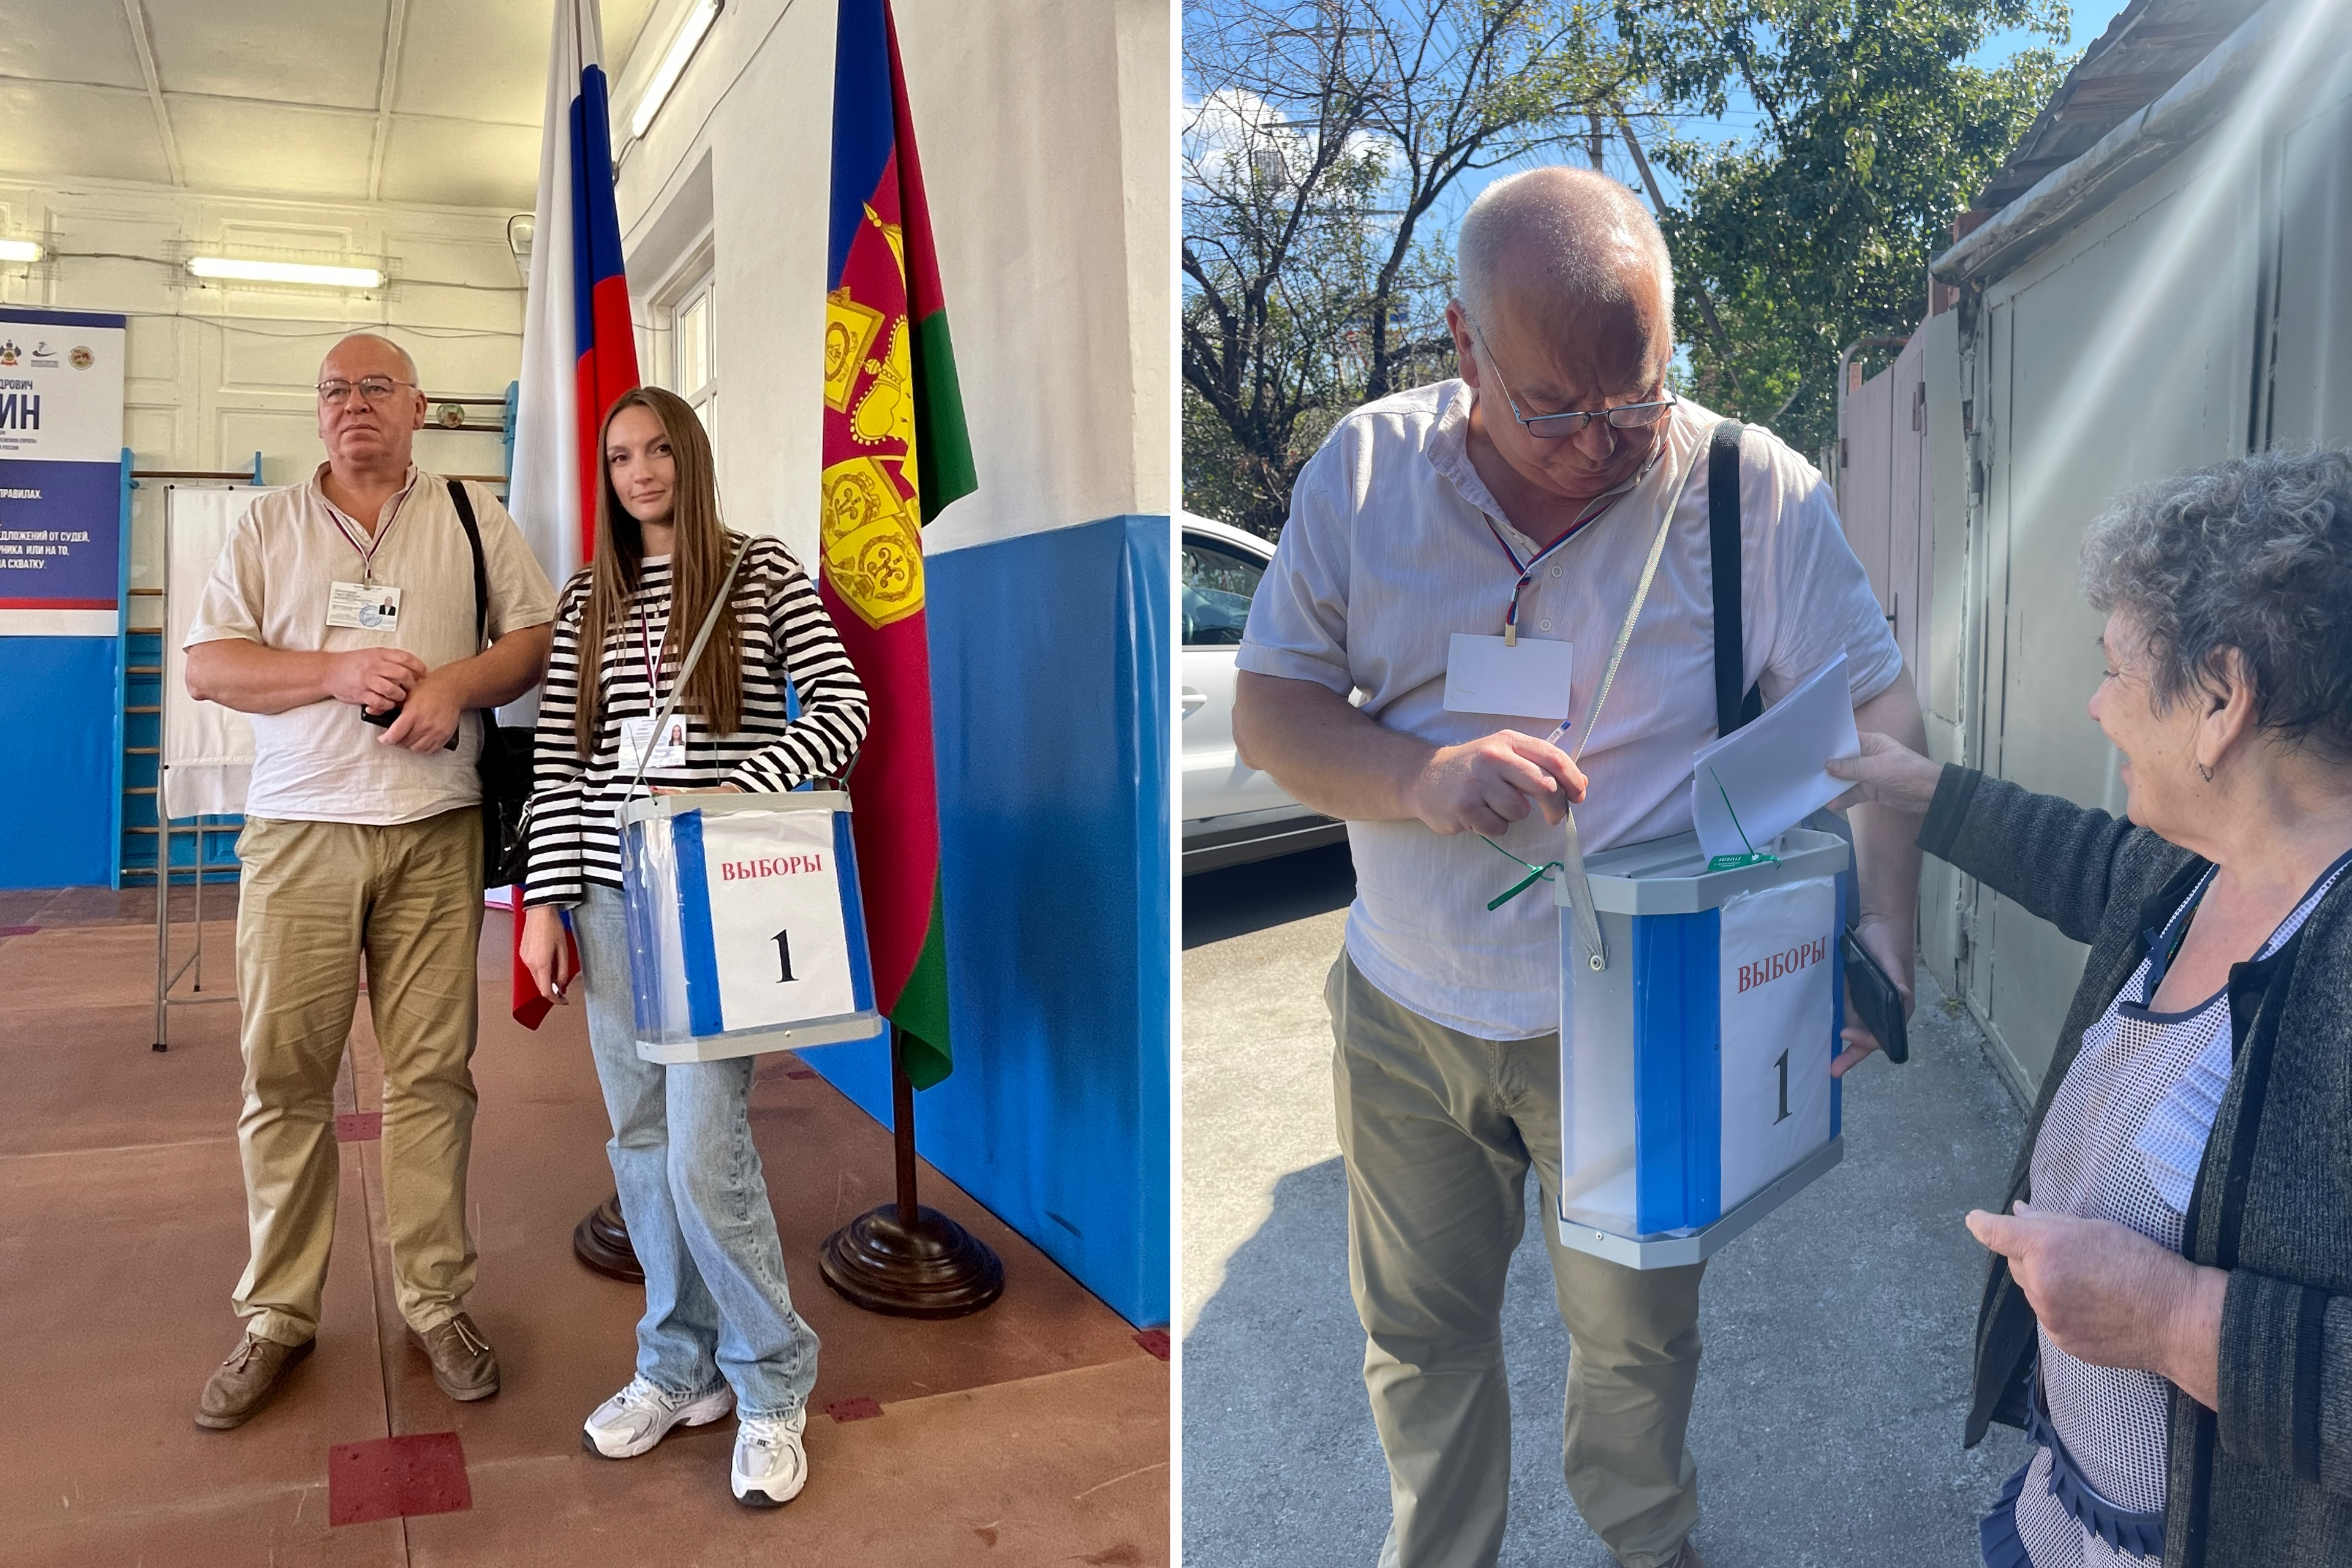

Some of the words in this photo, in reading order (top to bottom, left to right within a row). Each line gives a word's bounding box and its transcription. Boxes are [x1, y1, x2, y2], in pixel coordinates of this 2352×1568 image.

[0, 379, 33, 390] ДРОВИЧ
[0, 393, 40, 430] ИН
[0, 530, 48, 541] ДЛОЖЕНИЙ
[49, 531, 59, 541] ОТ
[61, 531, 90, 542] СУДЕЙ,
[26, 545, 43, 555] ИЛИ
[45, 546, 56, 555] НА
[58, 546, 70, 556] ТО,
[722, 854, 823, 881] ВЫБОРЫ
[770, 929, 799, 984] 1
[1737, 935, 1827, 994] ВЫБОРЫ
[1773, 1047, 1793, 1126] 1
